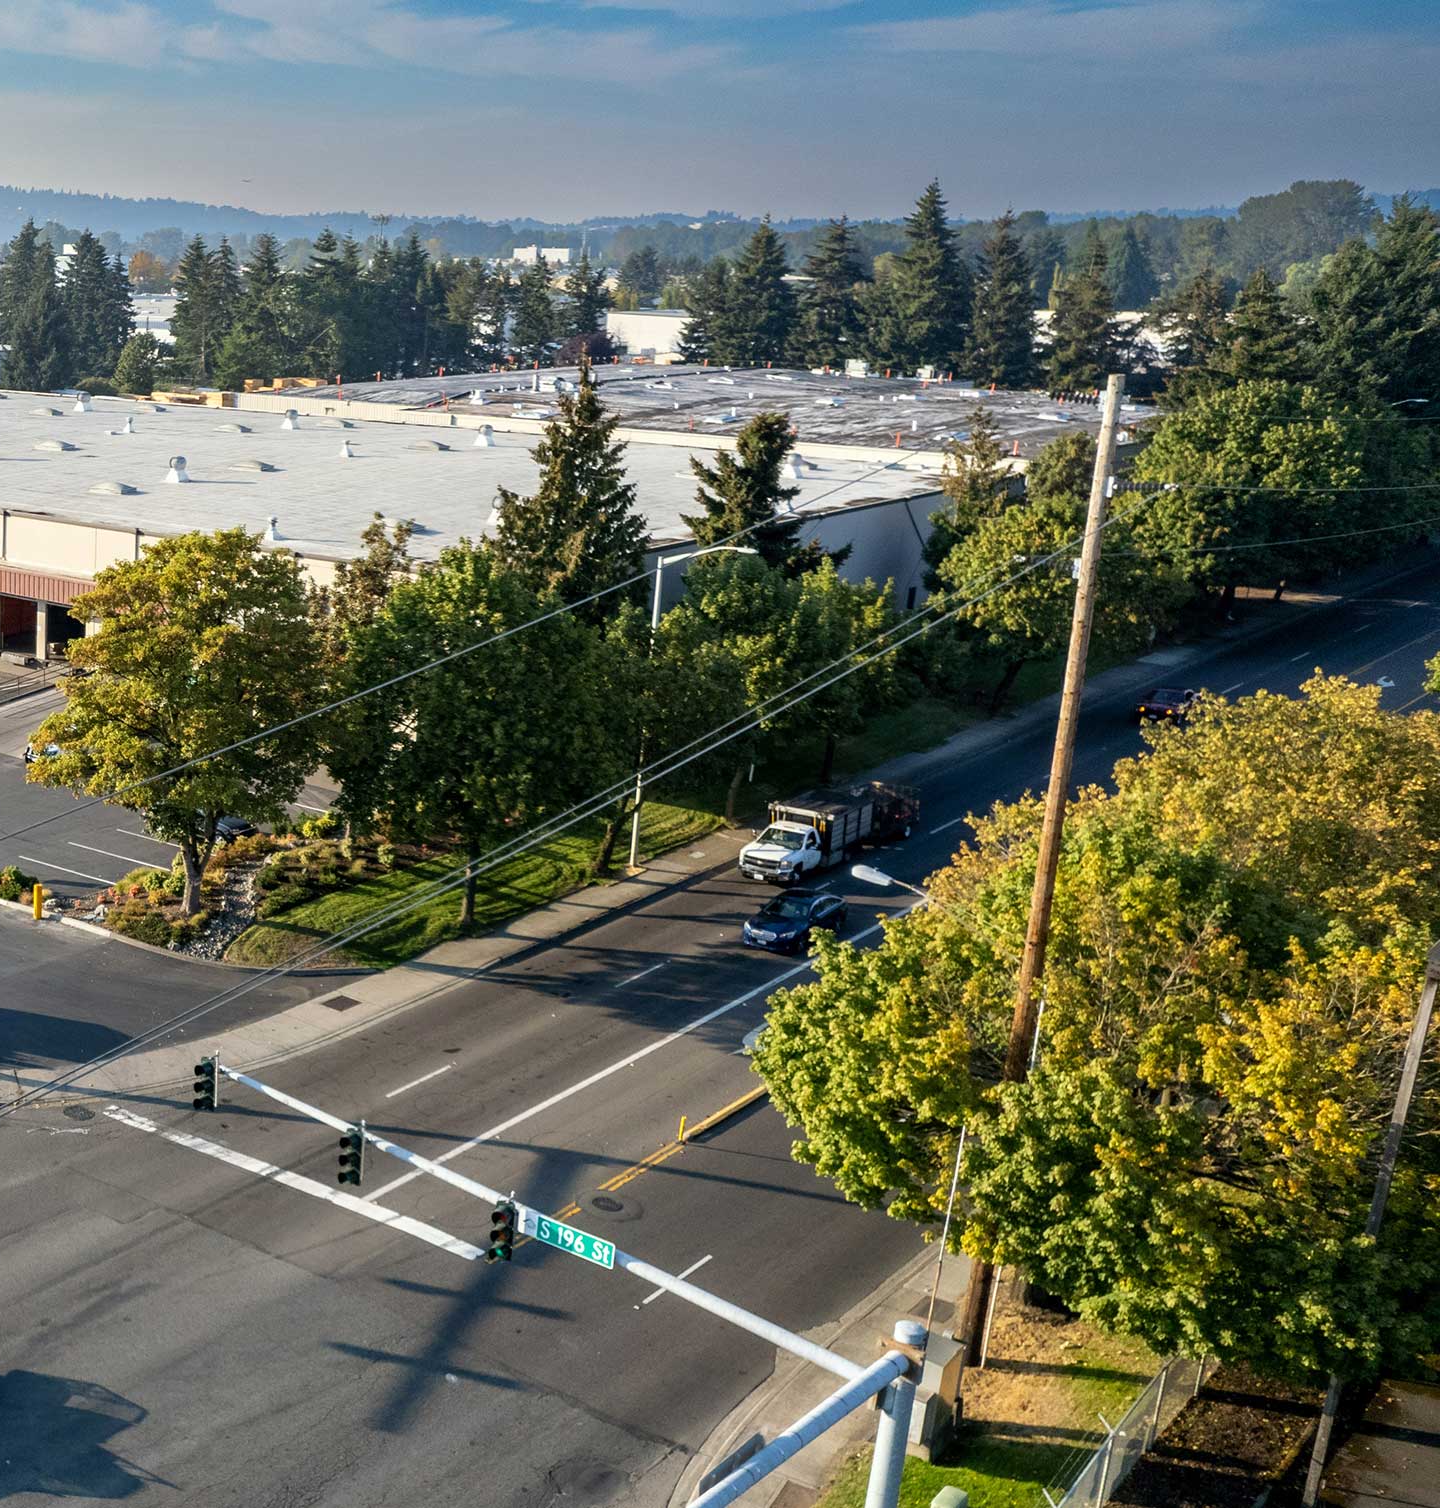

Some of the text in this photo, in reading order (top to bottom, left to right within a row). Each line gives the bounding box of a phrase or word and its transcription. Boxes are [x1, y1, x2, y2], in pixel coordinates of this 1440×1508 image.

[540, 1220, 611, 1264] S 196 St
